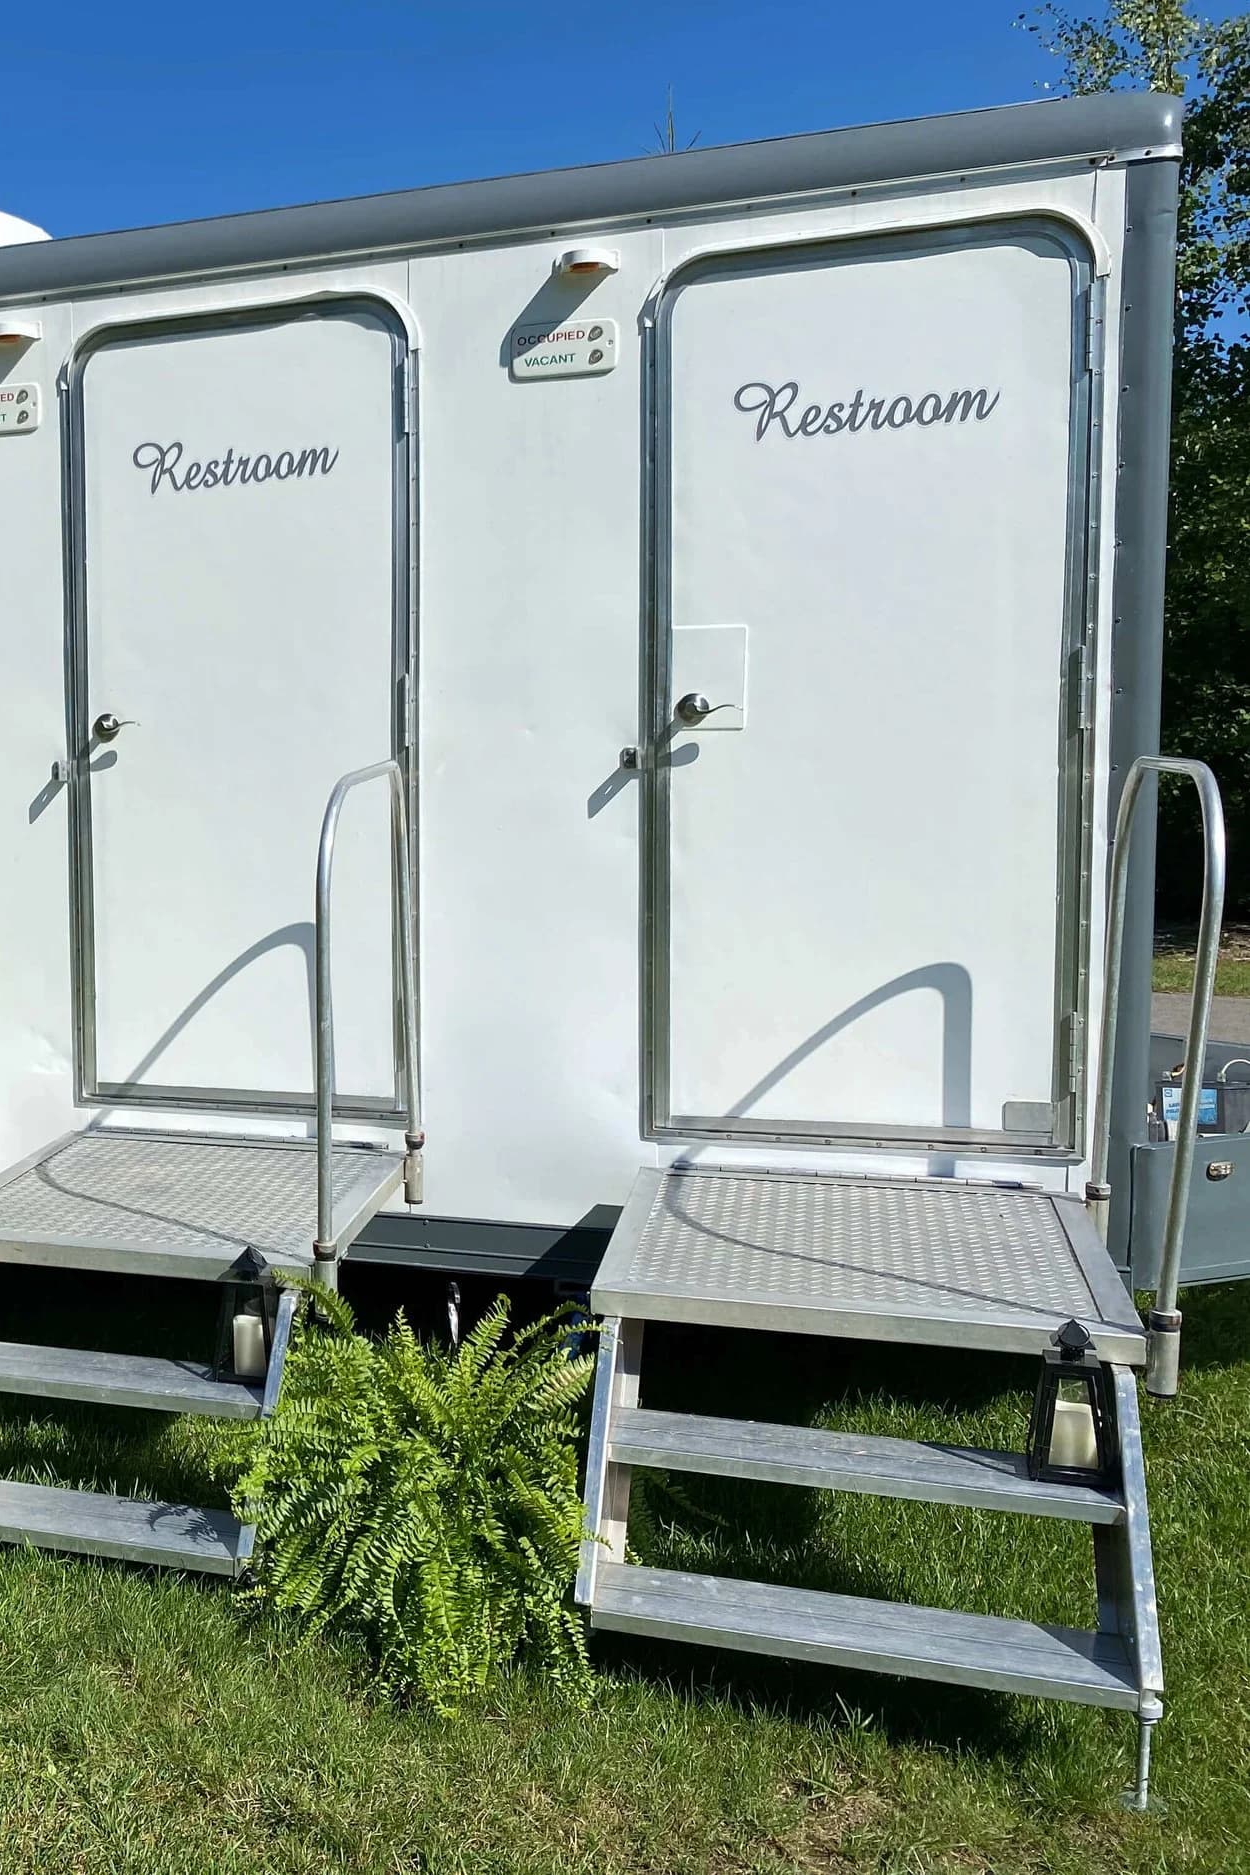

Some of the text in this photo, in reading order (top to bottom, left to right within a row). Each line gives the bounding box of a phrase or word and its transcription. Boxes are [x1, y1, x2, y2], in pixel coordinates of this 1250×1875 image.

[517, 330, 585, 346] OCCUPIED
[524, 353, 576, 367] VACANT
[733, 381, 1000, 442] Restroom
[132, 441, 340, 495] Restroom
